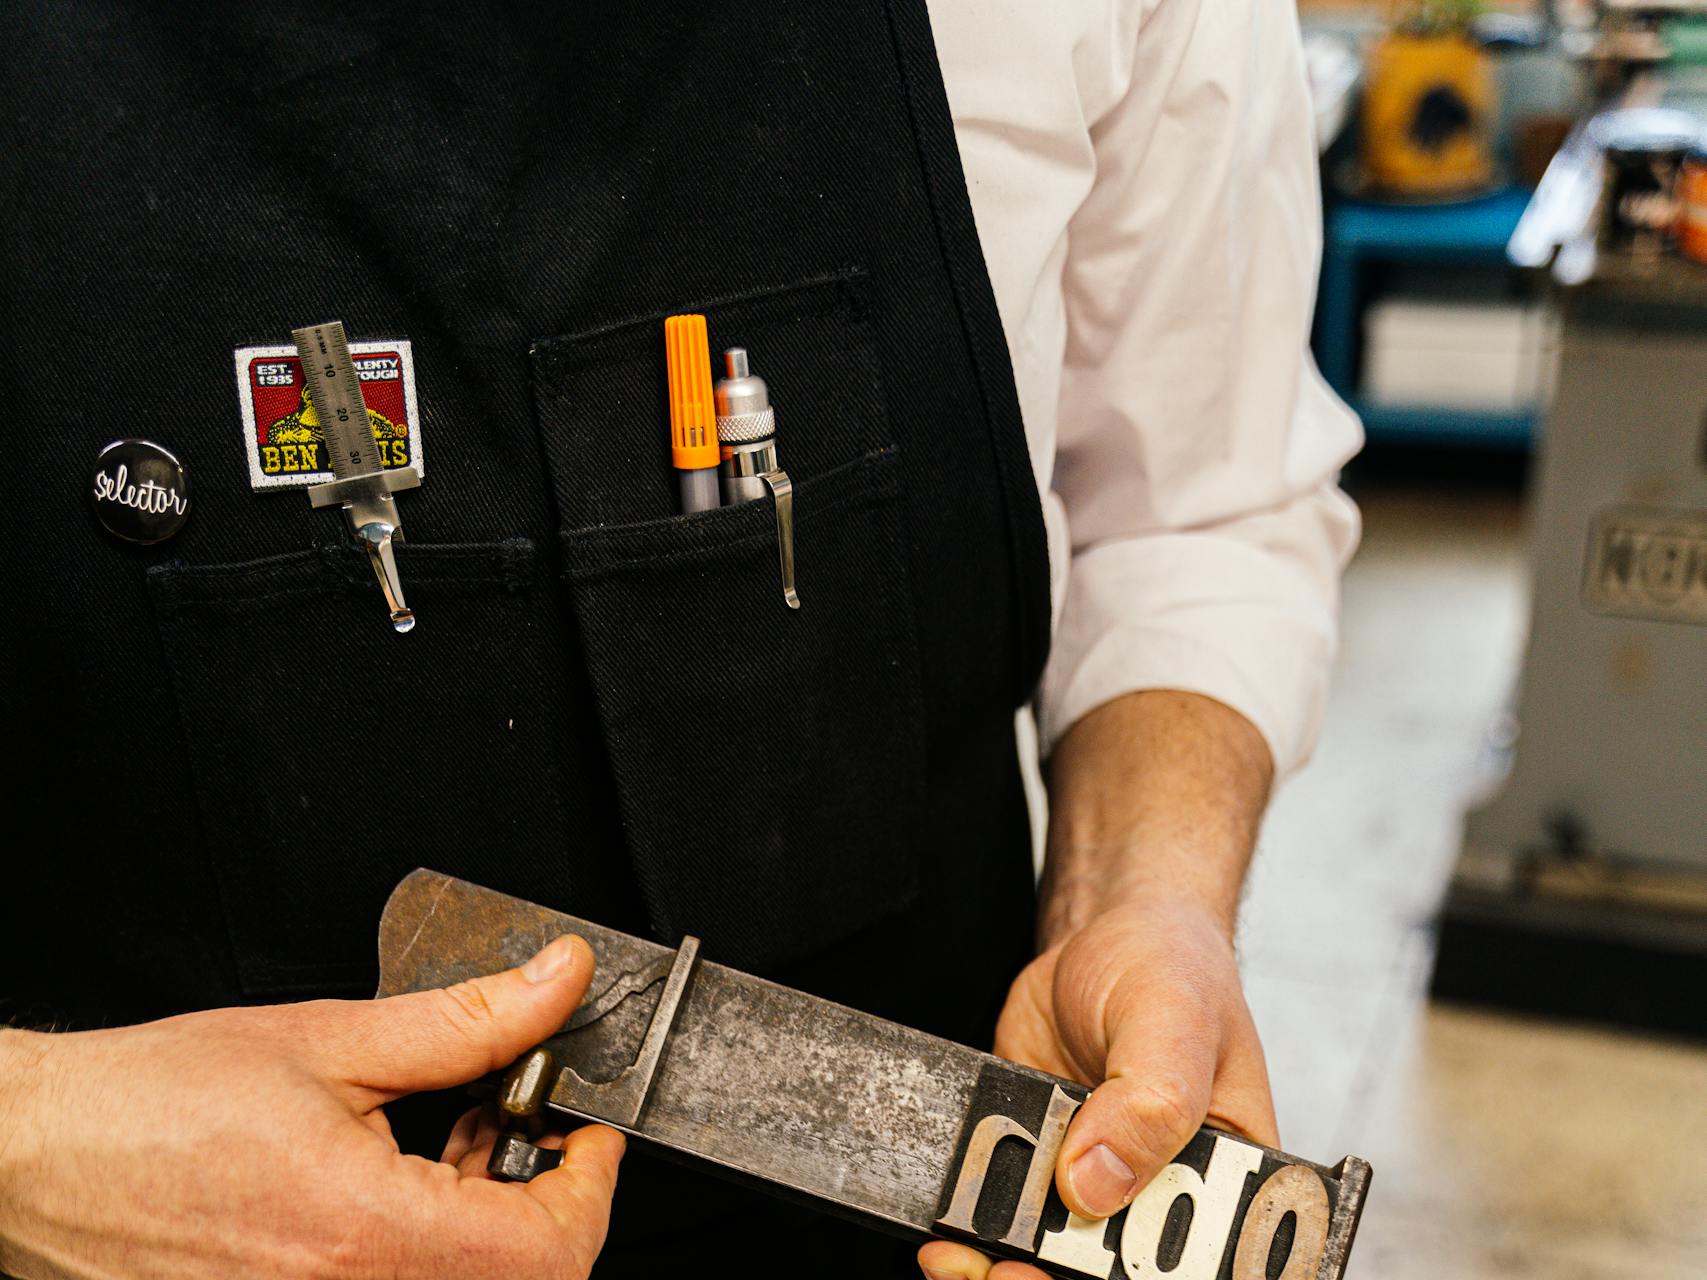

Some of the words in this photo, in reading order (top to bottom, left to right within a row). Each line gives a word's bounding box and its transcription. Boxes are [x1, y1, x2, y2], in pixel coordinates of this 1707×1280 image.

[257, 364, 293, 375] EST.
[323, 363, 336, 378] 10
[258, 374, 294, 385] 1935
[336, 408, 349, 422] 20
[262, 444, 318, 473] BEN
[350, 450, 362, 465] 30
[94, 464, 187, 515] selector
